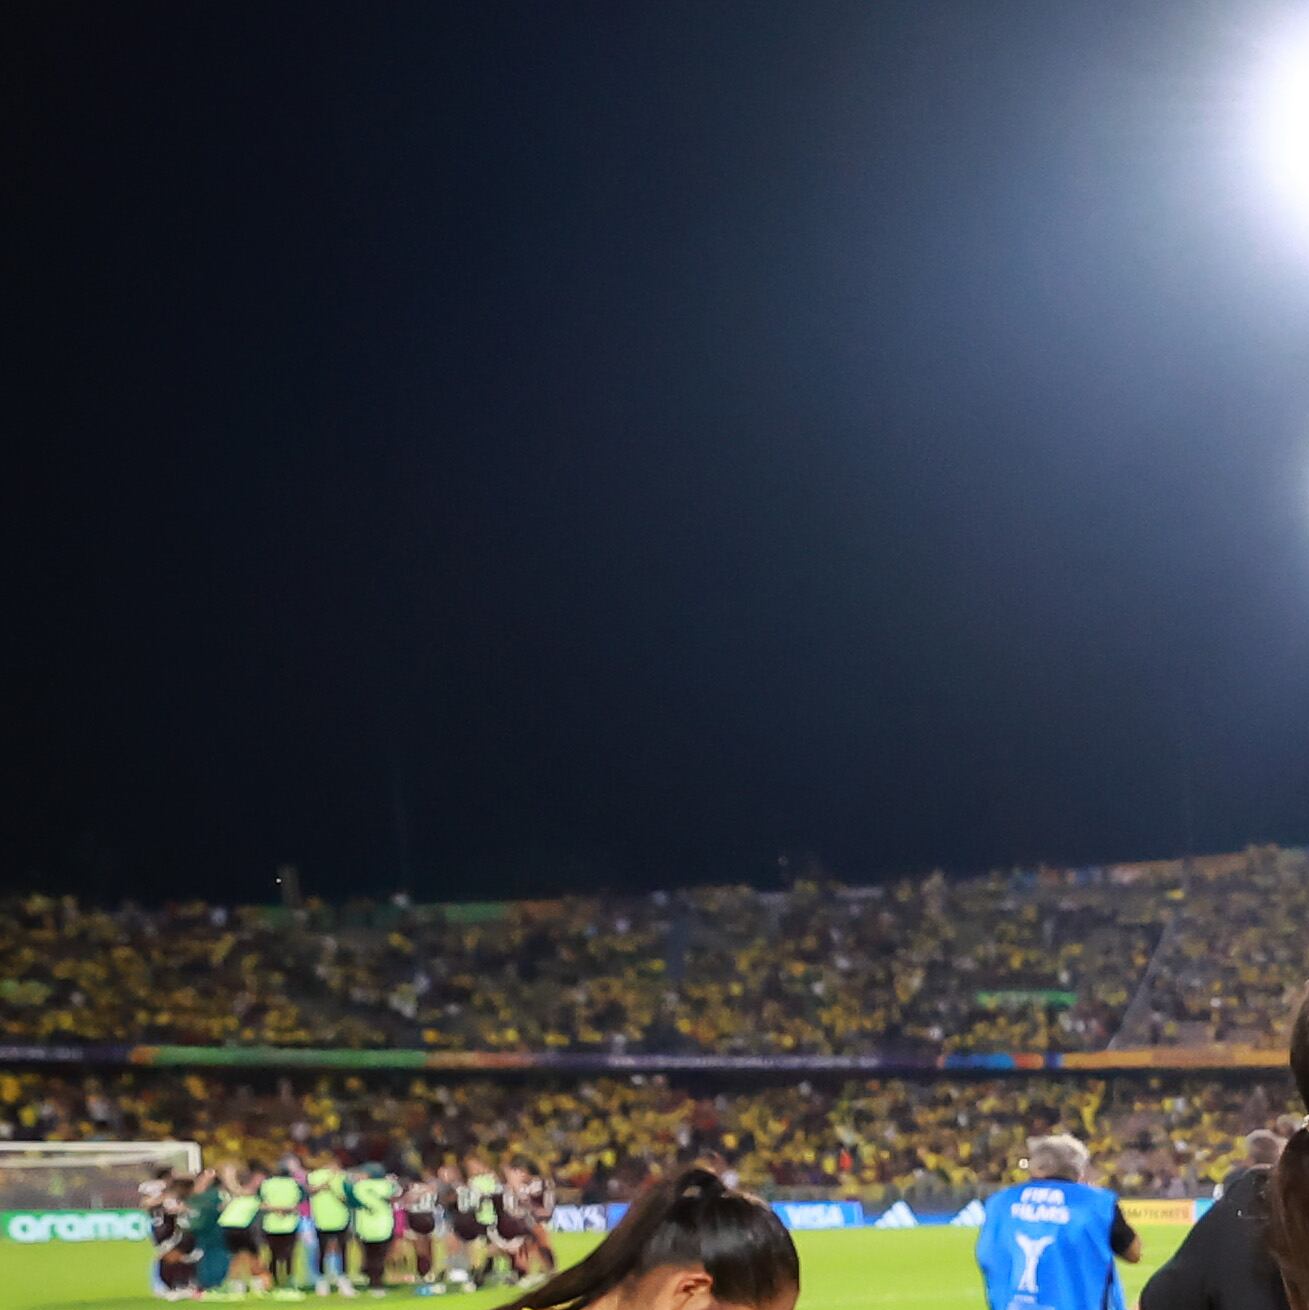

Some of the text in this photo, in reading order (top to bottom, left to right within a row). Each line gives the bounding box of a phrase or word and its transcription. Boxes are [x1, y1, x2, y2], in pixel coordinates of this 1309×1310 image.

[1020, 1187, 1065, 1204] FIFA
[785, 1204, 844, 1229] VISA
[1011, 1202, 1070, 1225] FILMS
